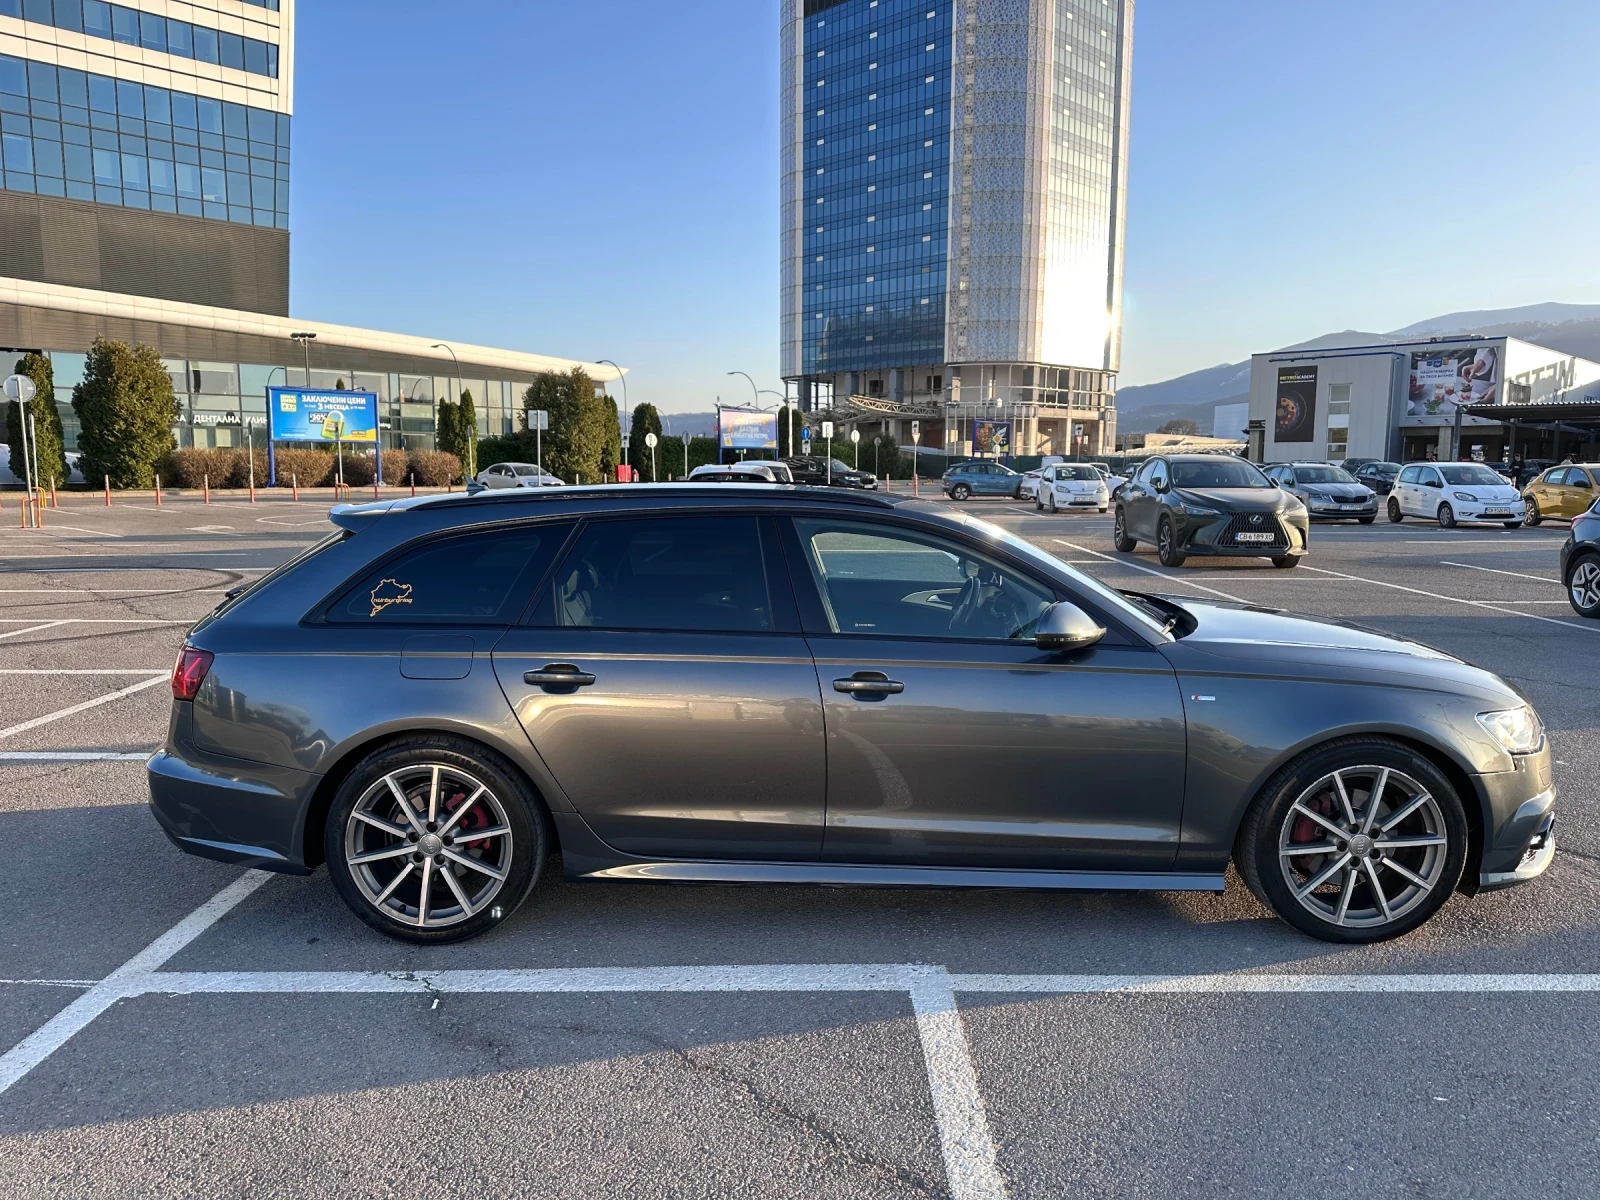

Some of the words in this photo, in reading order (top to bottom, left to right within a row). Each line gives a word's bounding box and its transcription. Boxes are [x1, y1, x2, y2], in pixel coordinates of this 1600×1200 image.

[301, 395, 346, 404] ЗАКЛЮЧЕНИ
[347, 397, 366, 405] ЦЕНИ
[193, 414, 241, 424] ДЕНТАЛНА
